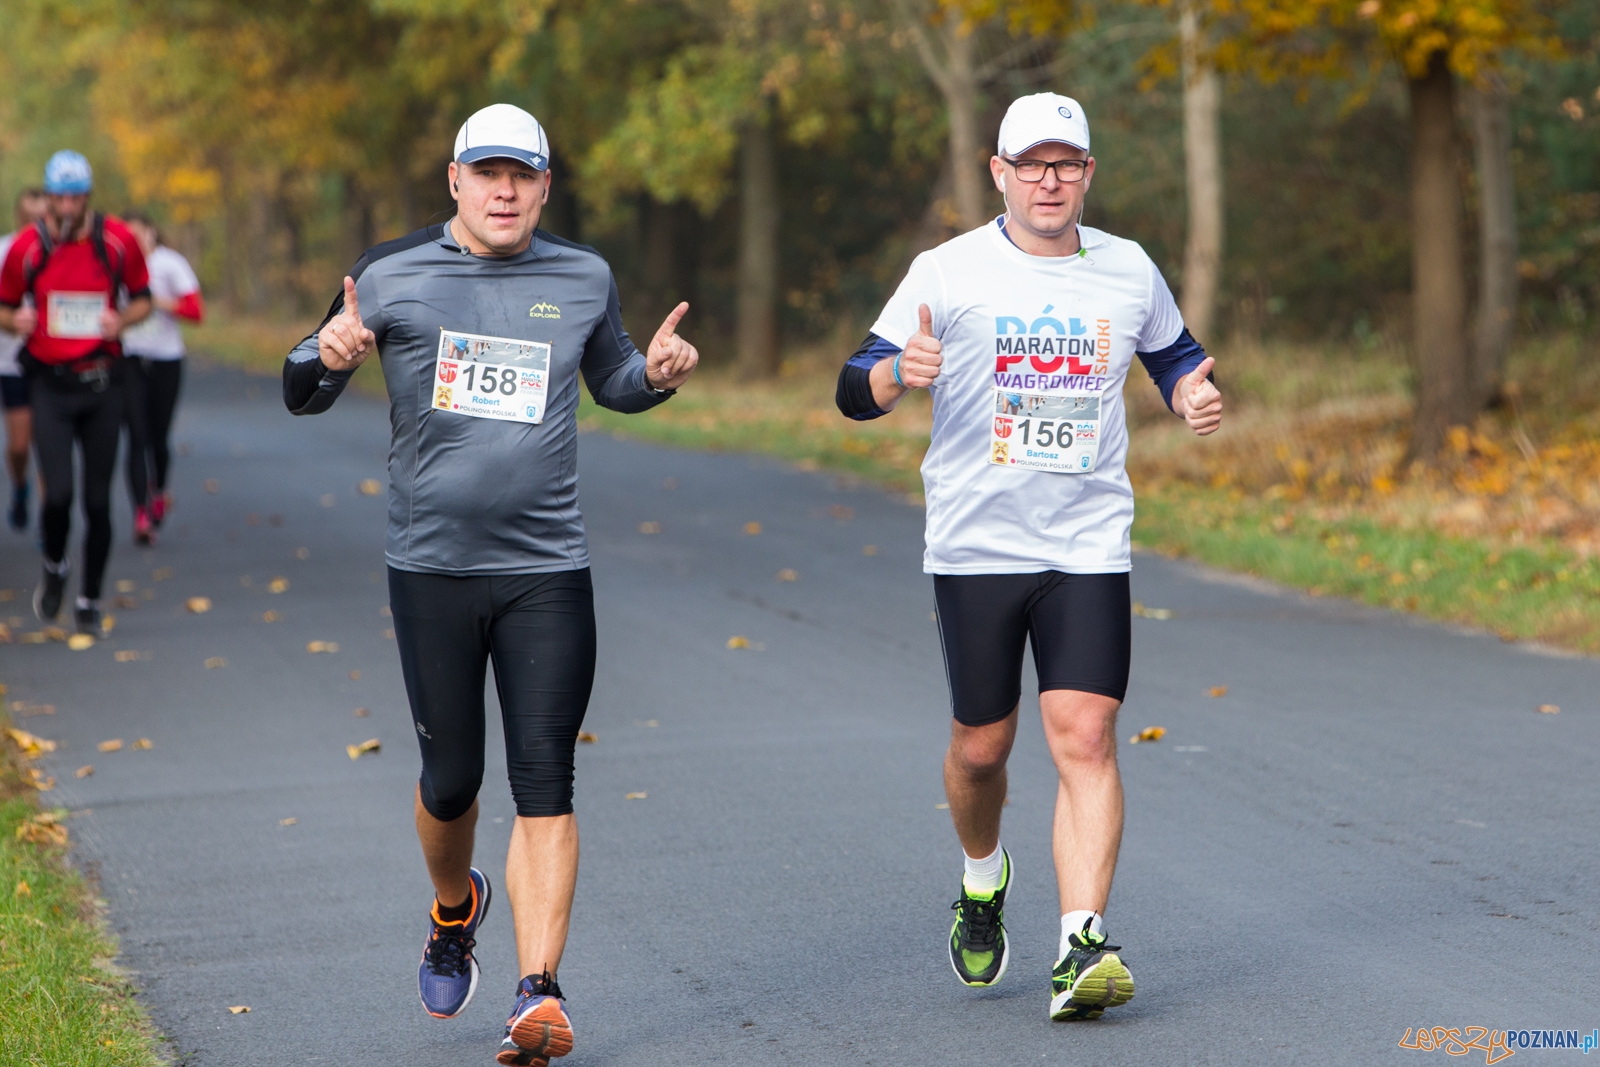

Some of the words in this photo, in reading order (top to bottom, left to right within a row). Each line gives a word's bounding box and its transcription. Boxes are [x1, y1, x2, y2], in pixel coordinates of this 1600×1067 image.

[996, 337, 1095, 356] MARATON
[1094, 318, 1111, 375] SKOKI
[463, 364, 517, 396] 158
[472, 396, 501, 406] Robert
[460, 405, 491, 415] POLINOVA
[492, 408, 517, 417] POLSKA
[1018, 419, 1074, 449] 156
[1026, 449, 1059, 459] Bartosz
[1016, 459, 1048, 468] POLINOVA
[1049, 461, 1073, 469] POLSKA
